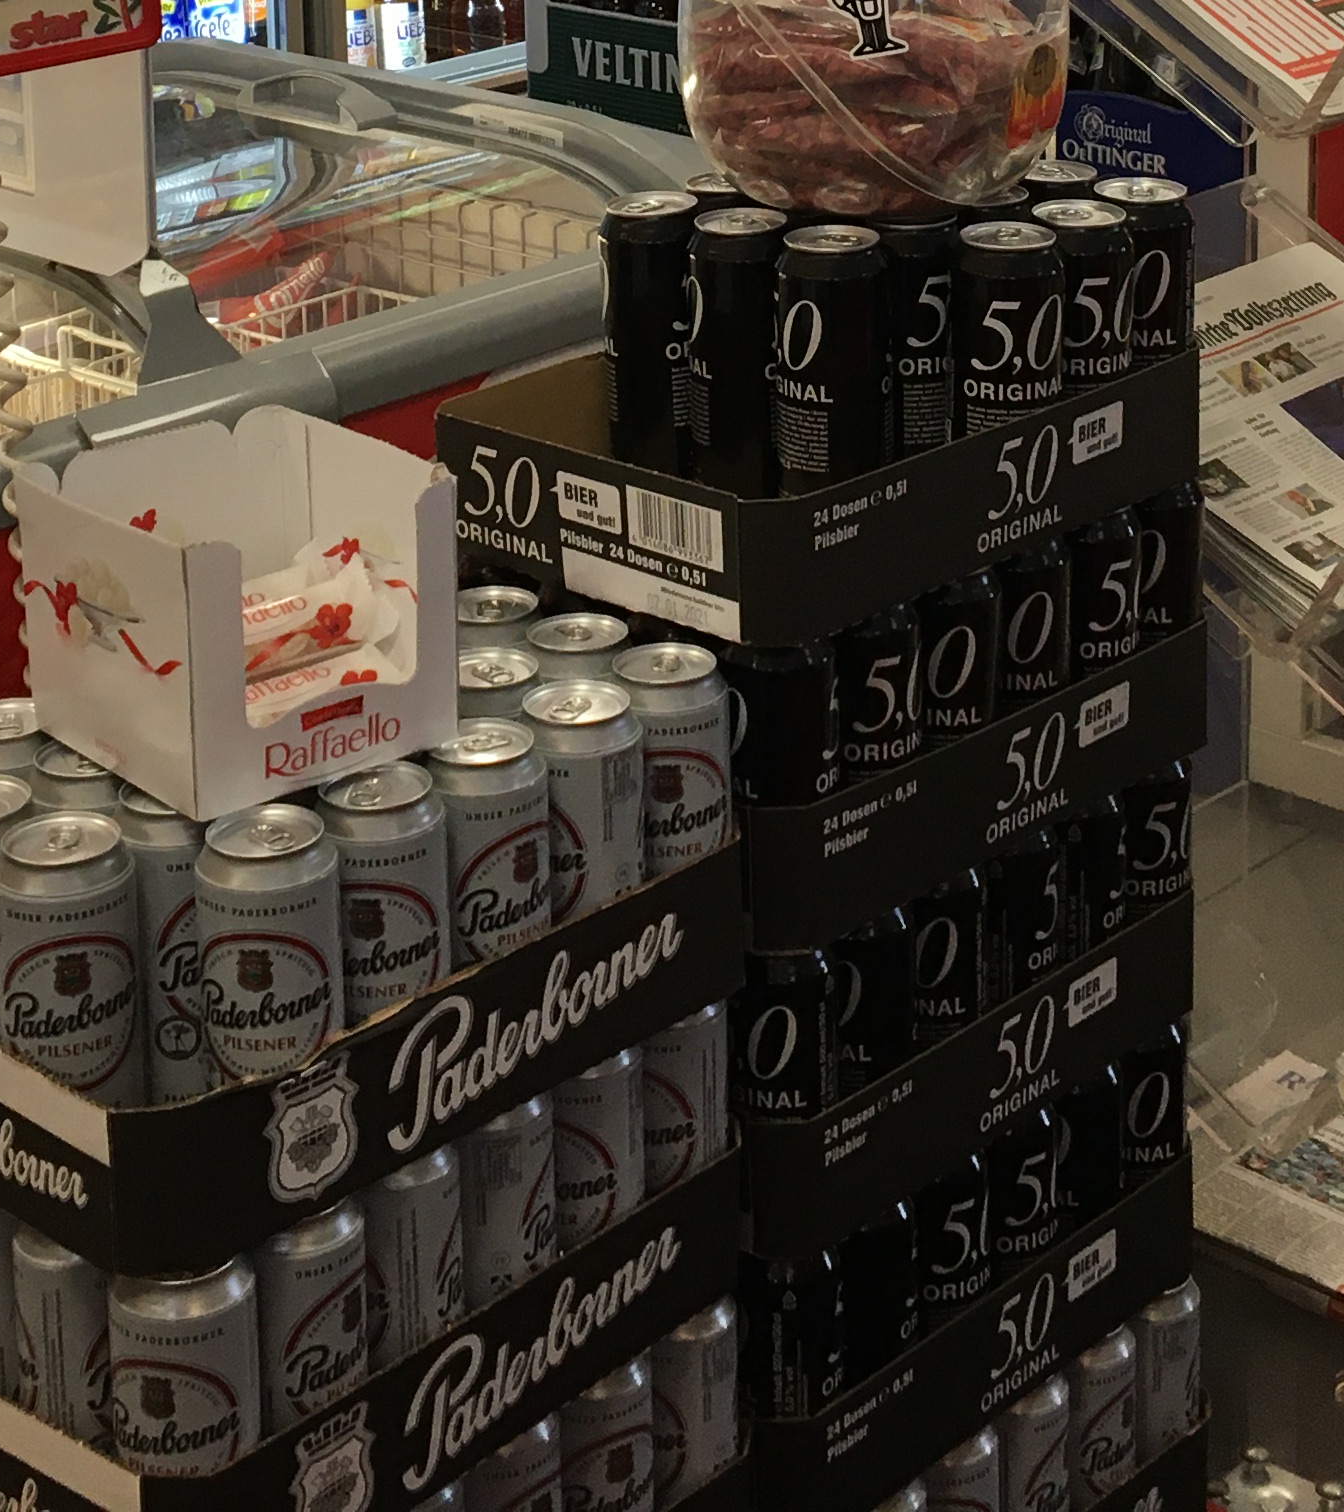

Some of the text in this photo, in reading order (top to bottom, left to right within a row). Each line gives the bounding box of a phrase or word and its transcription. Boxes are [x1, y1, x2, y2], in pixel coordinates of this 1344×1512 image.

[8, 6, 89, 51] star
[571, 35, 681, 90] VELTIN
[1077, 417, 1107, 441] BIER
[464, 444, 540, 528] 5,0
[563, 481, 598, 508] BIER
[987, 424, 1059, 520] 5,0
[576, 510, 594, 520] und
[814, 495, 868, 527] 24 Dosen
[976, 504, 1063, 554] ORIGINAL
[456, 519, 553, 564] ORIGINAL
[560, 528, 663, 574] Pilsbier 24 Dosen
[814, 523, 860, 551] Pilsbier
[1084, 698, 1113, 727] BIER
[265, 712, 401, 780] Raffaello
[996, 711, 1066, 812] 5,0
[823, 800, 878, 835] 24 Dosen
[985, 787, 1069, 844] ORIGINAL
[824, 826, 870, 858] Pilsbier
[200, 977, 332, 1030] Paderborner
[1072, 975, 1101, 1007] BIER
[37, 1034, 114, 1059] PILSENER
[222, 1034, 297, 1053] PILSENER
[386, 912, 685, 1155] Paderborner
[989, 993, 1056, 1099] 5,0
[978, 1074, 1061, 1133] ORIGINAL
[1072, 1247, 1101, 1281] BIER
[990, 1272, 1056, 1380] 5,0
[402, 1226, 684, 1491] Paderborner
[980, 1348, 1061, 1413] ORIGINAL
